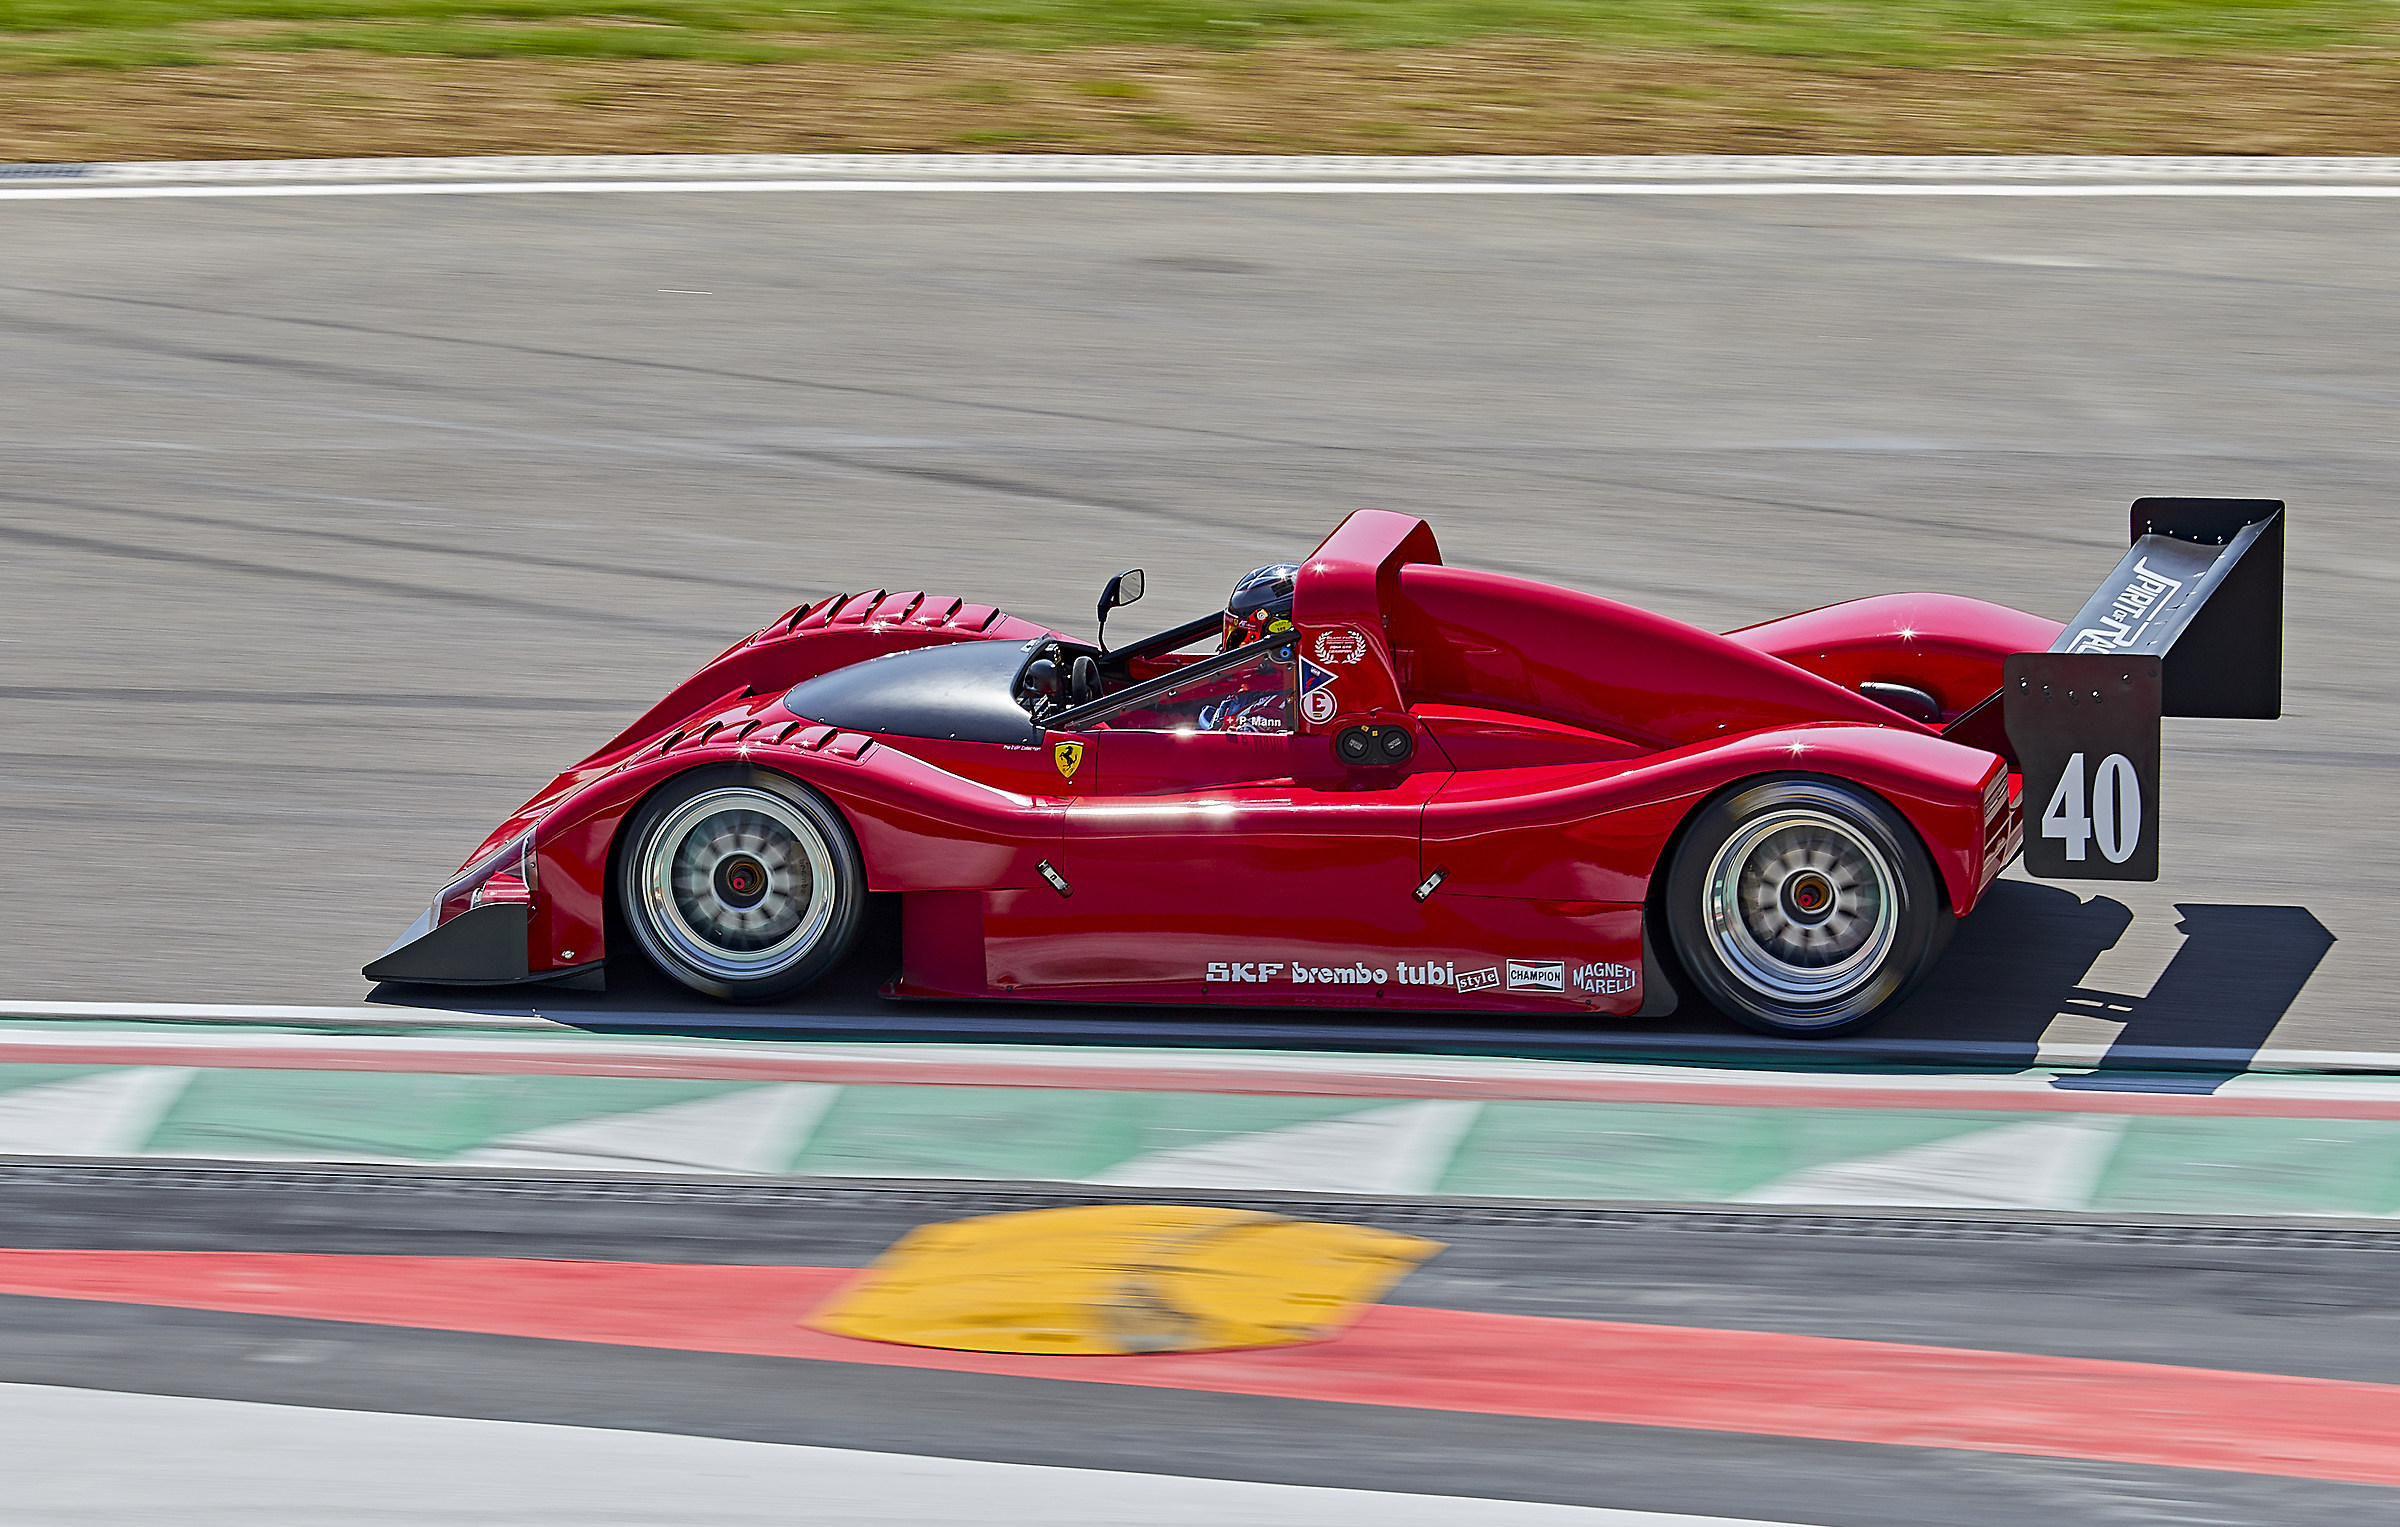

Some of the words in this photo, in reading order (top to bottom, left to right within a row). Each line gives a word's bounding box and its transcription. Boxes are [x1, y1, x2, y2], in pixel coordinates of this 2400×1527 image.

[2112, 556, 2183, 622] SPIRIT
[2112, 609, 2128, 623] OF
[2064, 615, 2151, 655] RAC
[1312, 692, 1326, 713] E
[1251, 716, 1282, 727] Mann
[2041, 752, 2142, 864] 40
[1205, 962, 1284, 983] SKF
[1291, 961, 1389, 984] brembo
[1395, 961, 1455, 985] tubi
[1458, 970, 1497, 988] style
[1510, 969, 1561, 983] CHAMPION
[1572, 962, 1636, 987] MAGNETI
[1572, 967, 1636, 994] MARELLI
